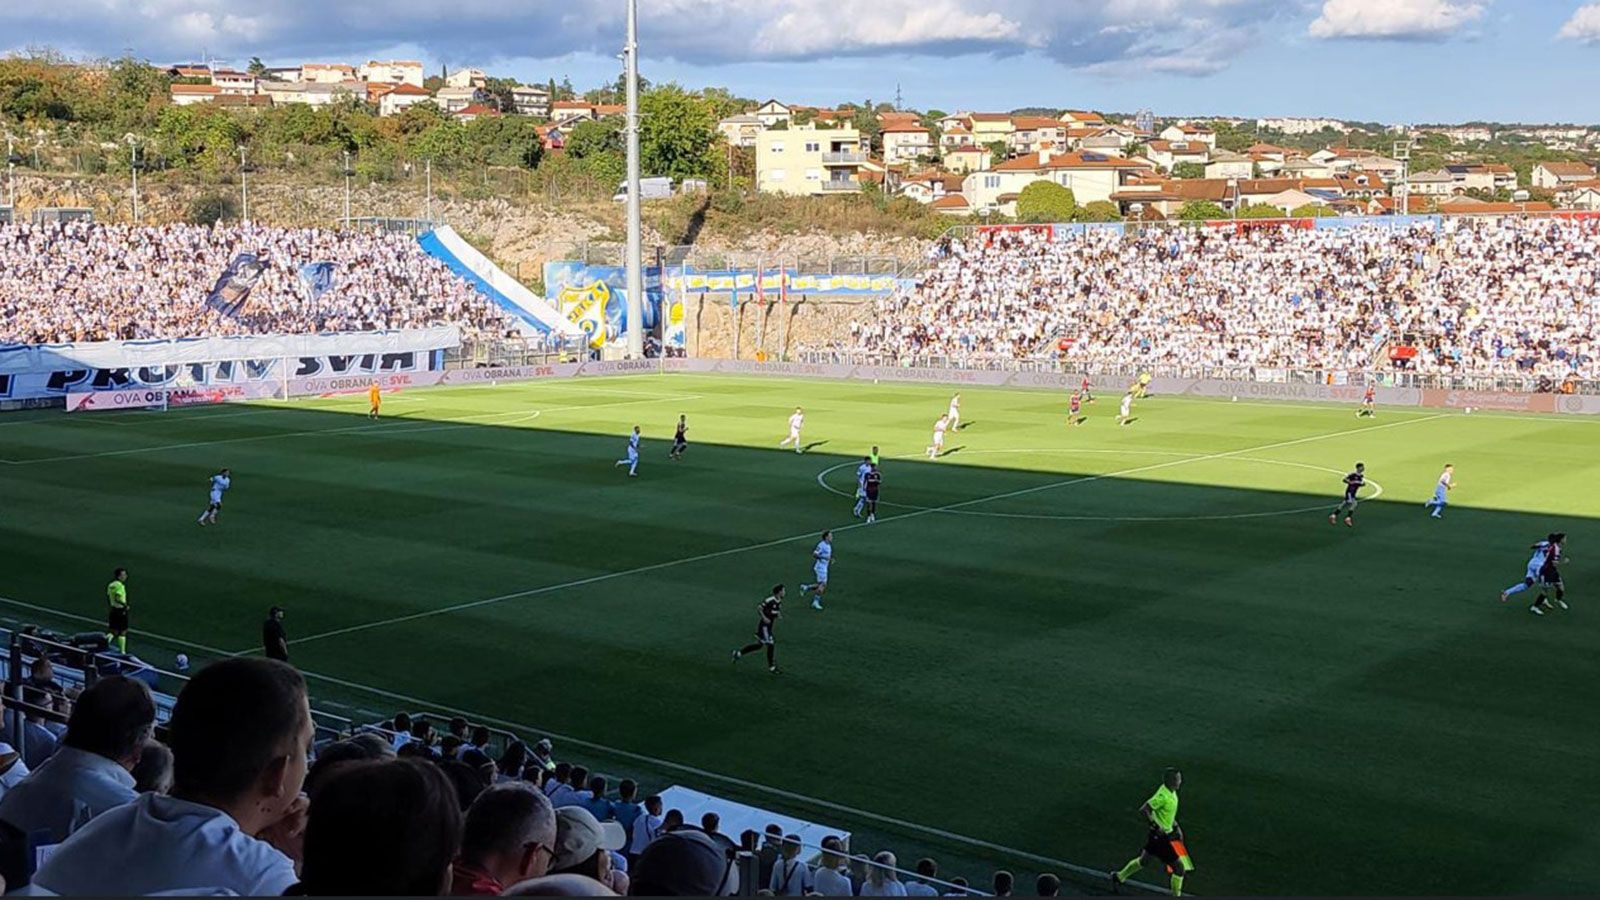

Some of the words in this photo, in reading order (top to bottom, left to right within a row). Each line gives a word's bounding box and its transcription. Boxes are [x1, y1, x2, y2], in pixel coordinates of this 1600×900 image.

[617, 361, 651, 371] OBRANA
[463, 370, 482, 381] OVA
[484, 369, 522, 379] OBRANA
[535, 366, 554, 376] SVE.
[896, 369, 937, 380] OBRANA
[305, 379, 328, 391] OVA
[330, 377, 373, 389] OBRANA
[389, 375, 413, 385] SVE.
[114, 391, 141, 404] OVA
[1219, 383, 1246, 394] OVA
[1251, 383, 1308, 397] OBRANA
[1309, 387, 1327, 399] JE
